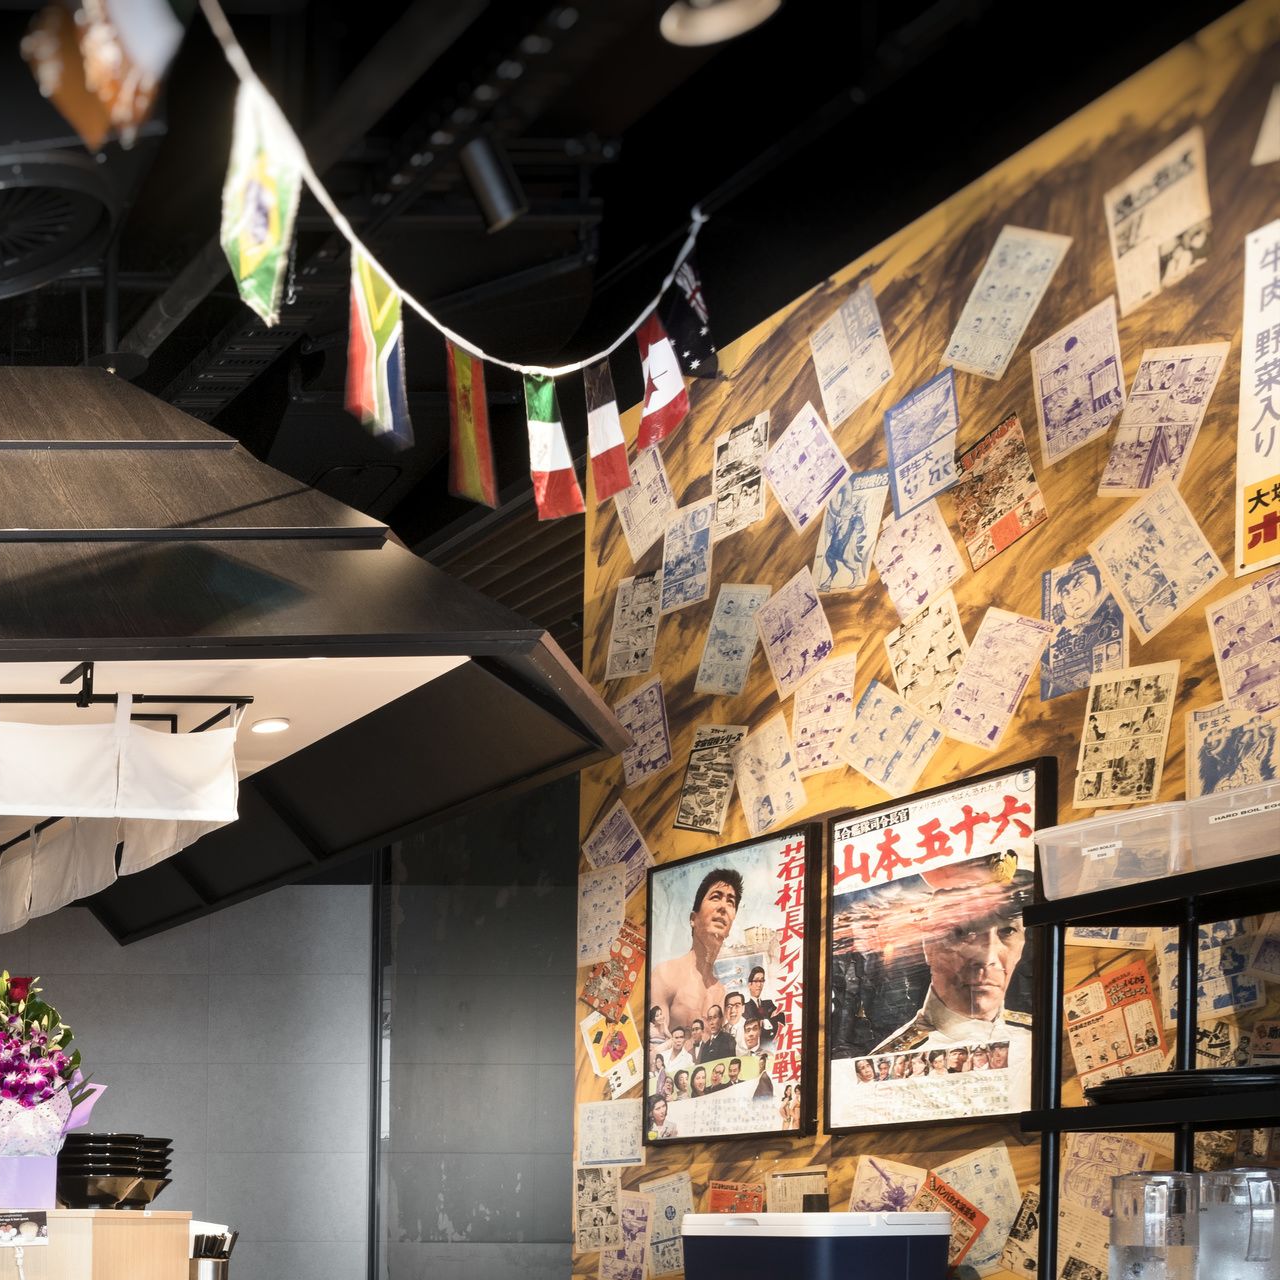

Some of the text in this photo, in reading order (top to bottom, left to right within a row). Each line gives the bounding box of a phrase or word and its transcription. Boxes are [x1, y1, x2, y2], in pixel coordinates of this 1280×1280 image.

[1199, 714, 1231, 732] 野生犬
[833, 794, 1033, 886] 山本五十六
[1214, 812, 1238, 821] HARD
[1240, 807, 1262, 816] BOIL
[771, 843, 805, 1084] 若社長レインボー作戦
